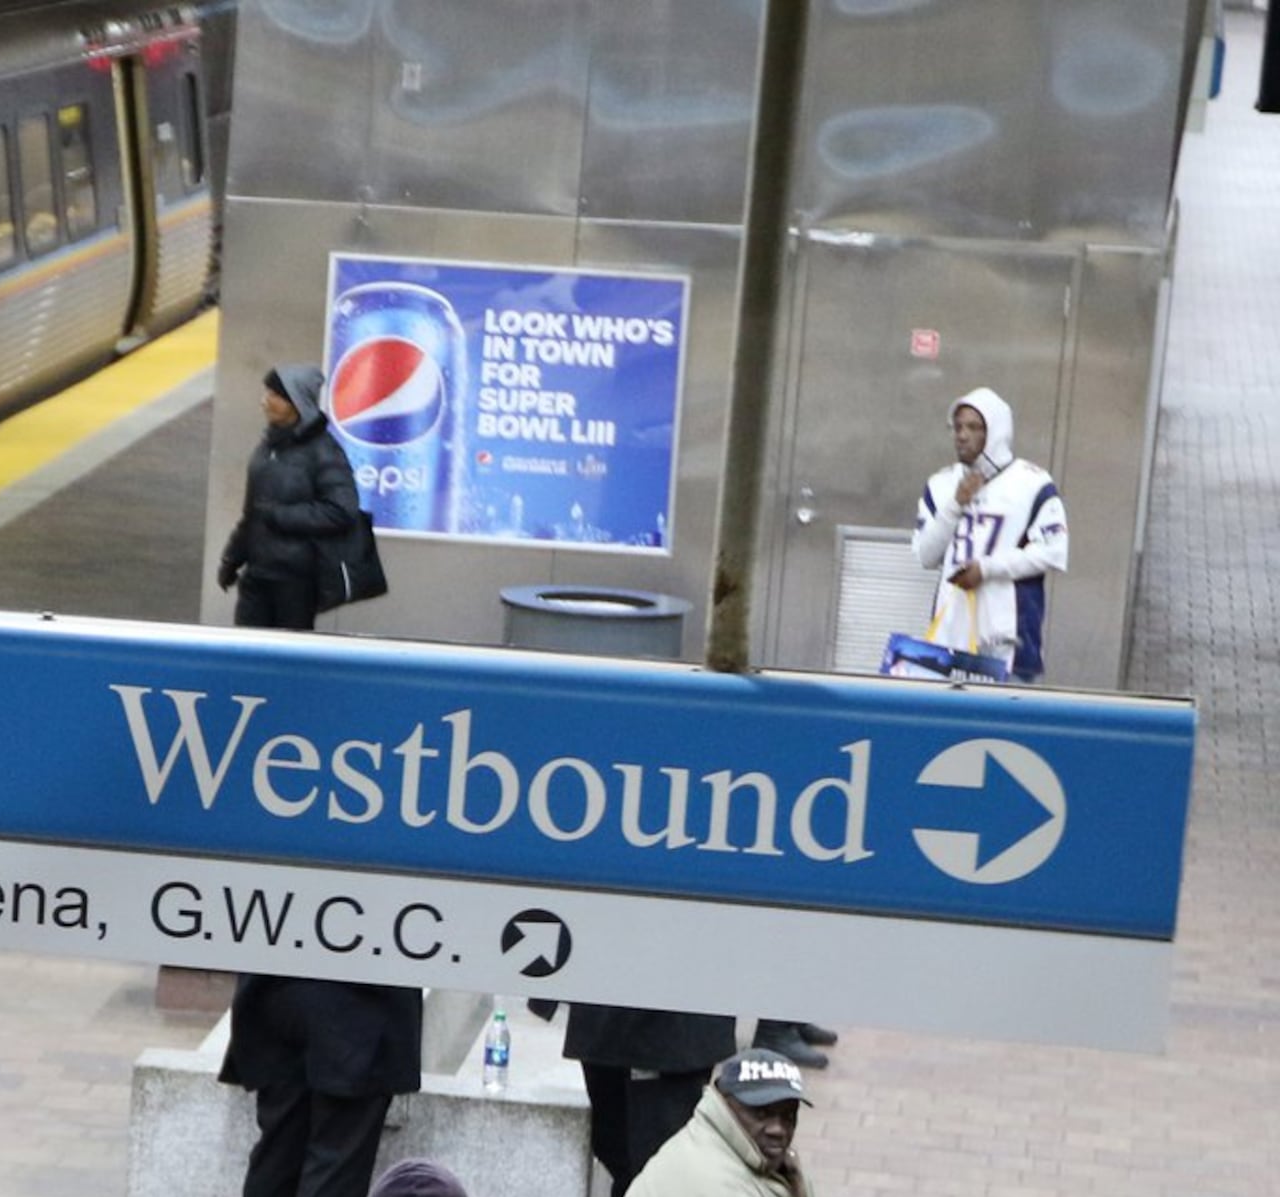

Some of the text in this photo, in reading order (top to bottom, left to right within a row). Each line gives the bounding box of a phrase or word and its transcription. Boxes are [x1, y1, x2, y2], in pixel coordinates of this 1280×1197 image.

[483, 308, 676, 346] LOOK WHO'S
[483, 335, 615, 369] IN TOWN
[480, 361, 541, 388] FOR
[477, 387, 577, 417] SUPER
[476, 413, 615, 446] BOWL LIII
[354, 463, 429, 497] epsi
[108, 684, 874, 864] Westbound
[151, 882, 461, 963] G.W.C.C.
